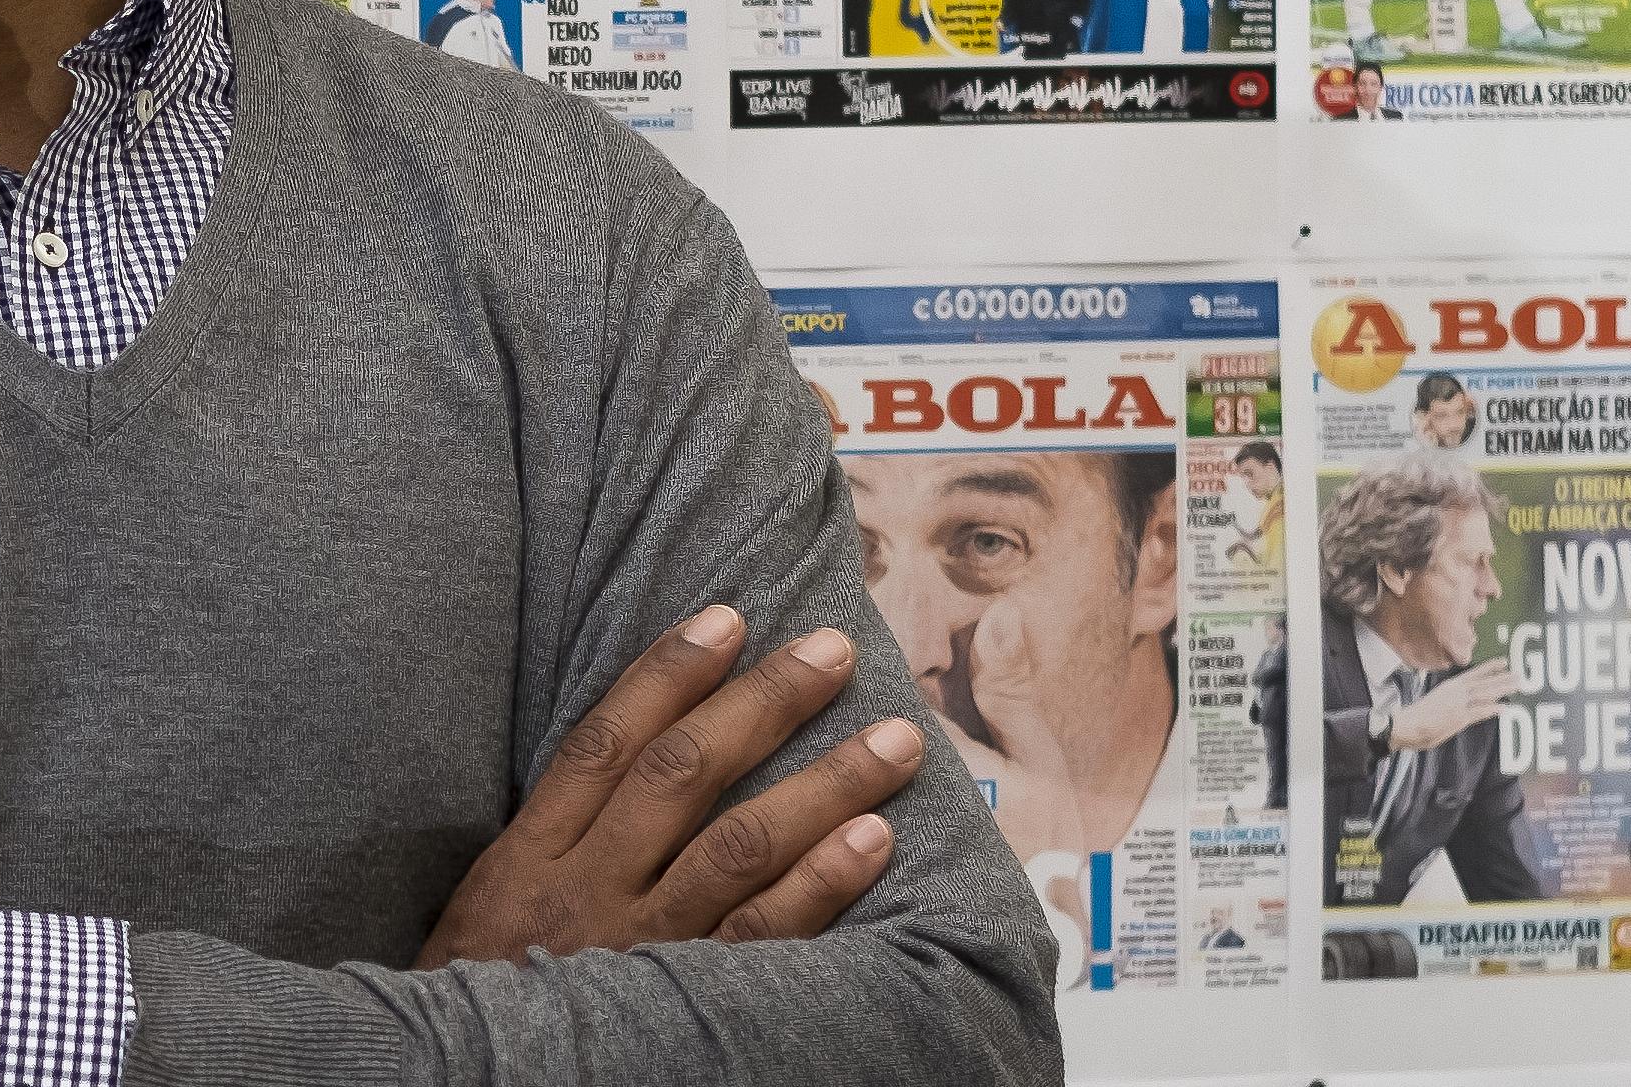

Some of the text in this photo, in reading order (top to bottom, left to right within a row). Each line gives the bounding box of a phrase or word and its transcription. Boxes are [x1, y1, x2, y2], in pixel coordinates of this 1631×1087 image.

[548, 22, 599, 41] TEMOS
[548, 47, 591, 66] MEDO
[572, 70, 682, 91] NENHUM JOGO
[1418, 84, 1474, 106] COSTA
[1331, 302, 1416, 354] A
[863, 375, 1176, 435] BOLA
[1486, 390, 1594, 424] CONCEIÇÃO
[1485, 428, 1562, 453] ENTRAM
[1500, 702, 1568, 774] DE
